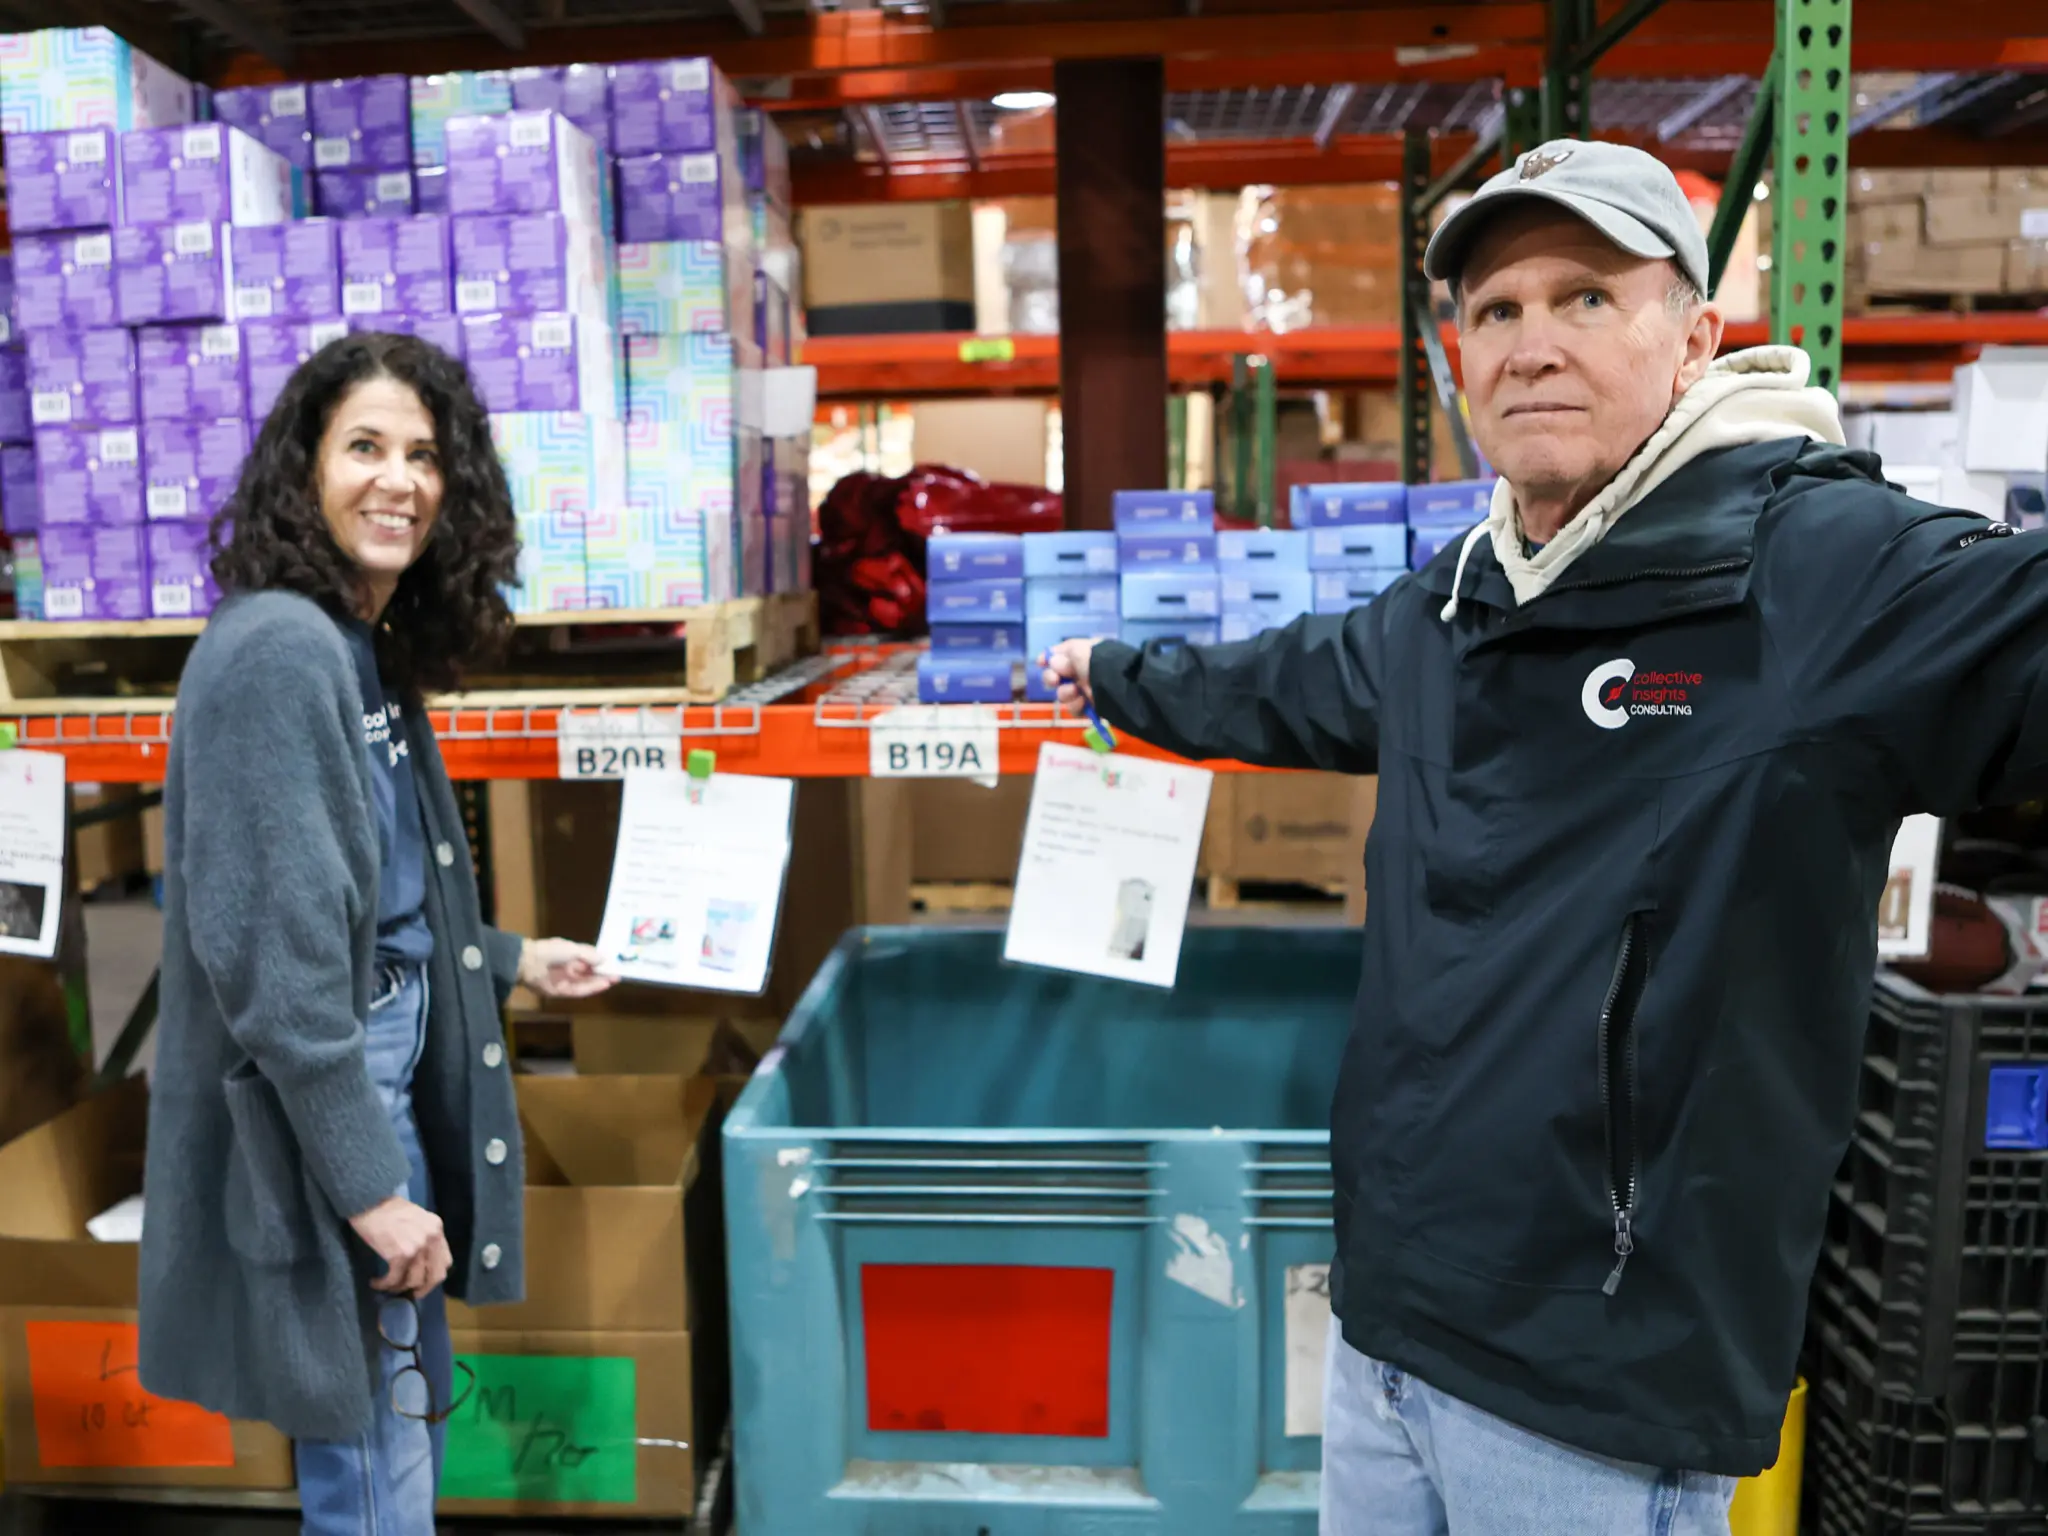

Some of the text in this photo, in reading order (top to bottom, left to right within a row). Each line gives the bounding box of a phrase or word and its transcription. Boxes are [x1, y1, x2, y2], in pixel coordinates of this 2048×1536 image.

[1633, 671, 1702, 684] collective
[1632, 688, 1686, 703] insights
[1630, 704, 1692, 716] CONSULTING
[576, 746, 666, 776] B20B
[888, 741, 982, 771] B19A
